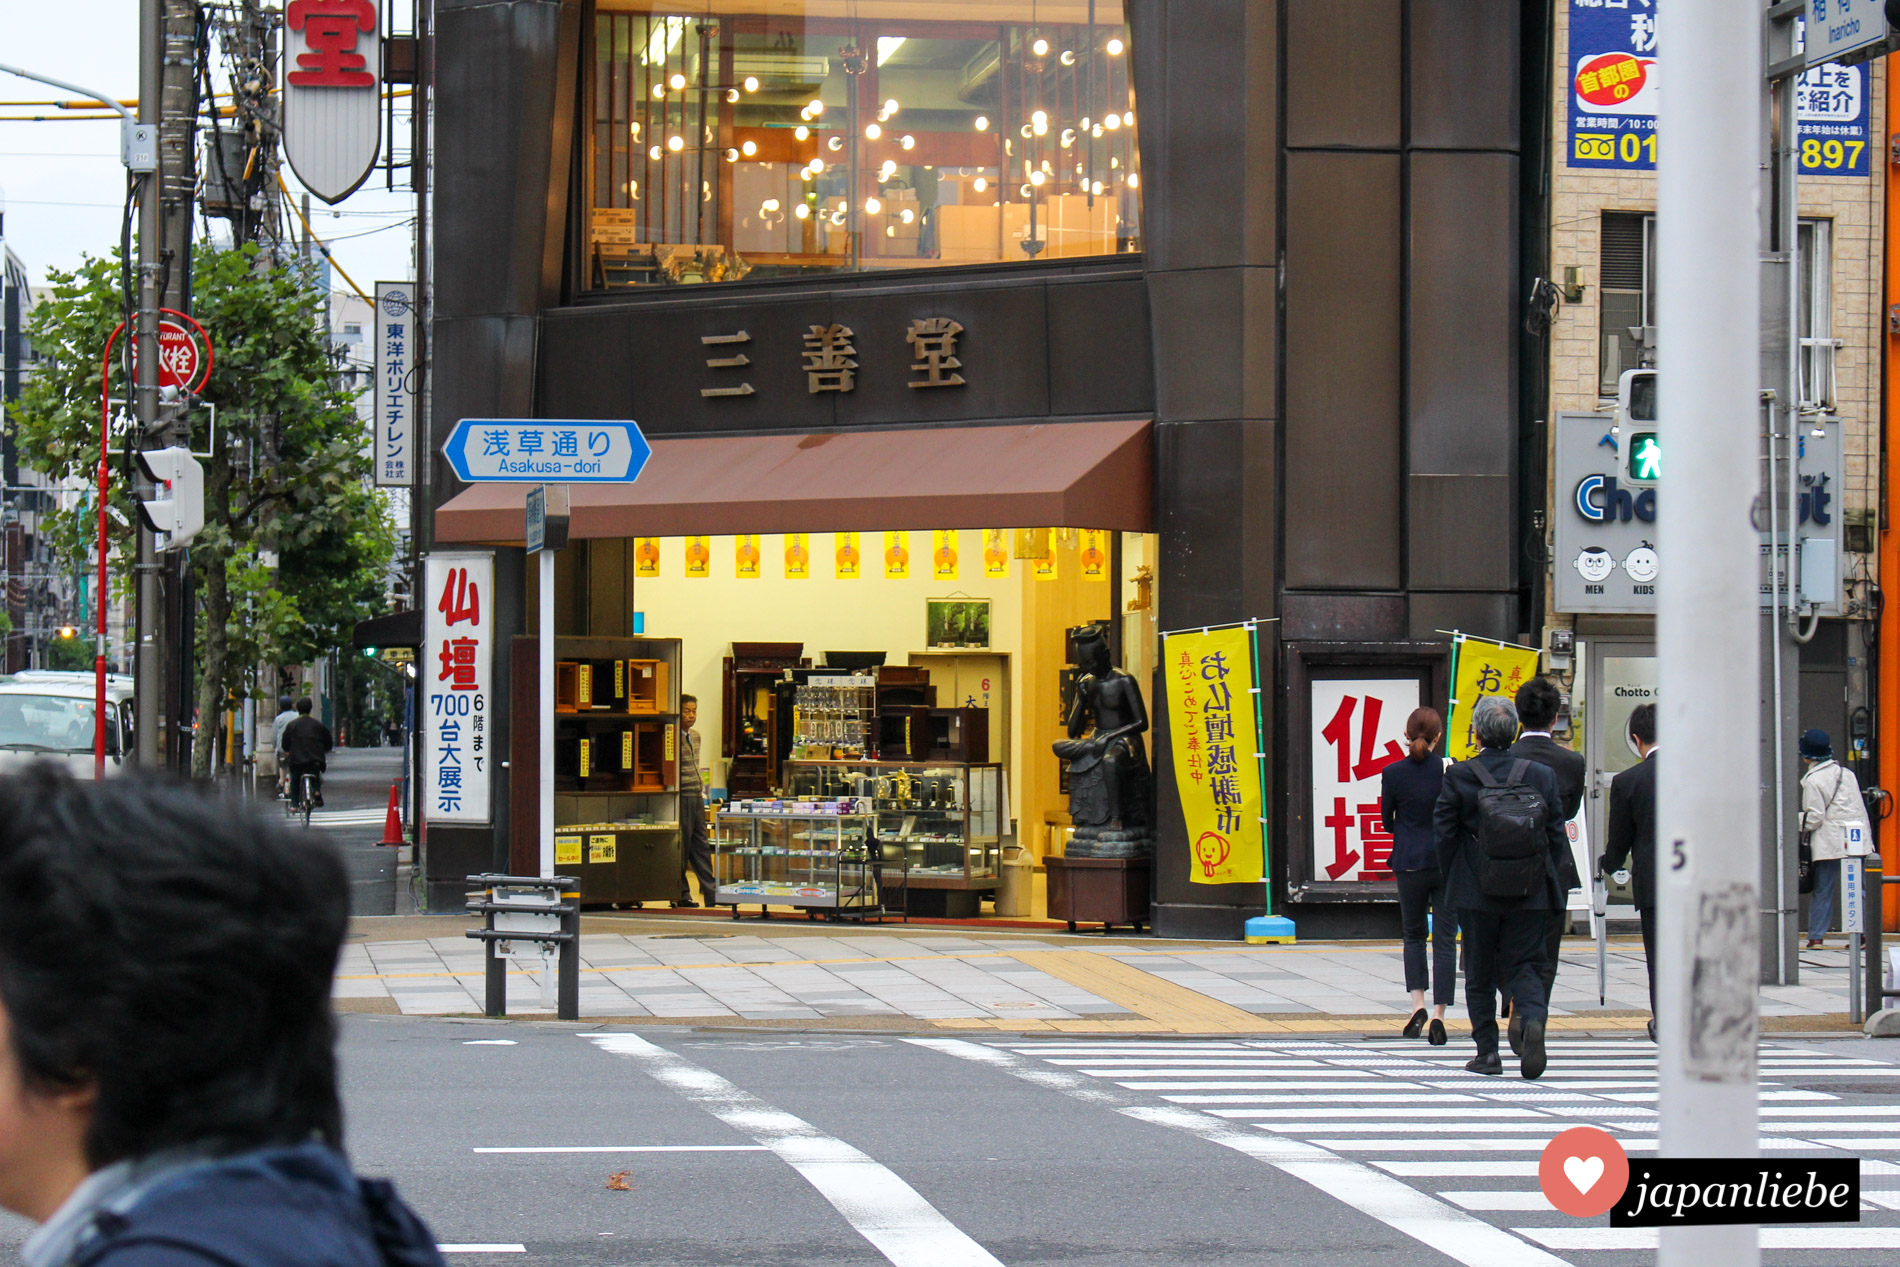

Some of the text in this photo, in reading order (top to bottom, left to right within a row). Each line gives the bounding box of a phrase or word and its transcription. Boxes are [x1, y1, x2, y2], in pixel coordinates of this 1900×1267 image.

[1630, 12, 1658, 51] 秋
[1828, 18, 1861, 44] Inaricho
[1578, 58, 1641, 94] 首都圏
[1613, 84, 1630, 98] の
[1619, 133, 1865, 169] 01 897
[160, 332, 185, 341] DRANT
[701, 317, 967, 397] 三善堂
[386, 323, 405, 458] 東洋ポリエチレン
[482, 429, 611, 457] 浅草通り
[498, 458, 601, 474] Asakusa-dori
[1574, 473, 1657, 524] Cho
[1585, 584, 1604, 595] MEN
[1633, 585, 1655, 595] KIDS
[438, 567, 480, 691] 仏壇
[1614, 686, 1651, 697] Chotto
[473, 694, 485, 772] 6階まで
[1321, 695, 1406, 882] 仏壇
[1671, 840, 1687, 871] 5
